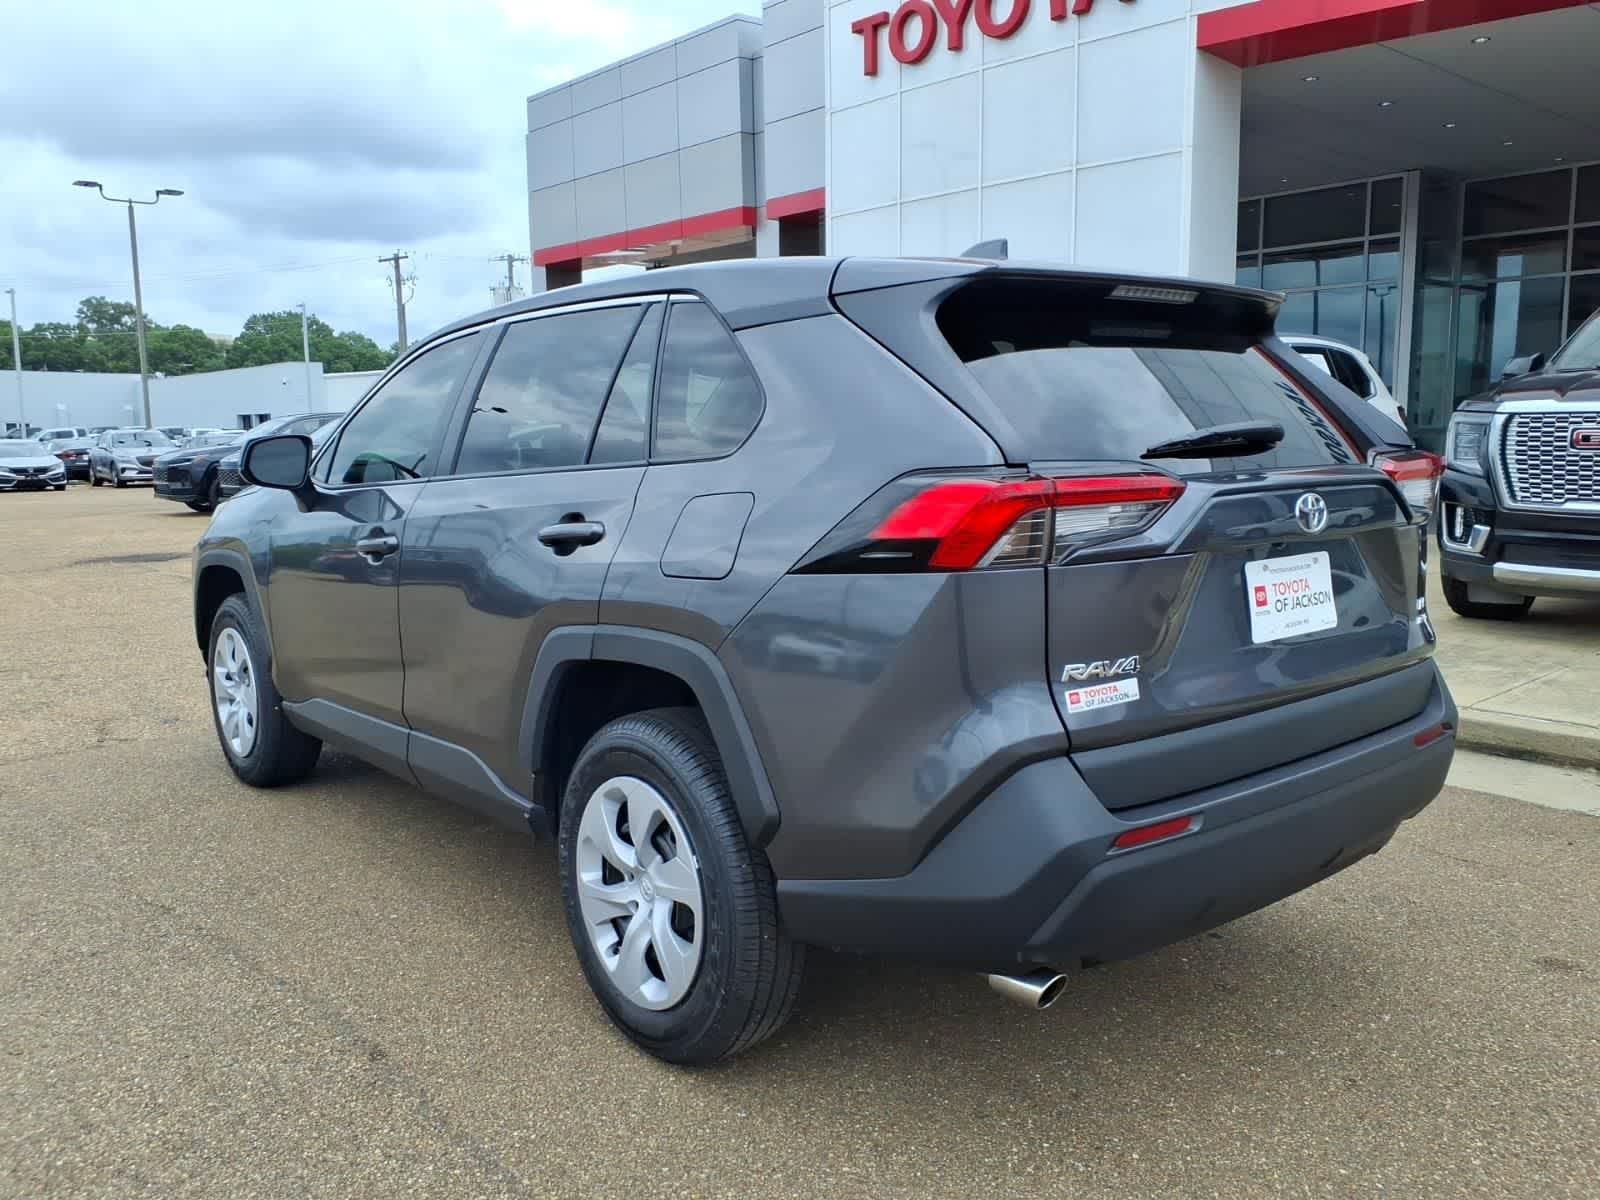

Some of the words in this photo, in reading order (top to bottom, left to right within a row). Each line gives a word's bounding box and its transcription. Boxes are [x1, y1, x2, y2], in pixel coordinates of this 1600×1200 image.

[851, 0, 1136, 77] TOYO
[1272, 578, 1310, 597] TOYOTA
[1274, 597, 1289, 613] OF
[1290, 590, 1331, 610] JACKSON
[1061, 655, 1140, 681] RAV4
[1083, 685, 1119, 698] TOYOTA
[1085, 699, 1095, 708] OF
[1097, 693, 1130, 704] JACKSON
